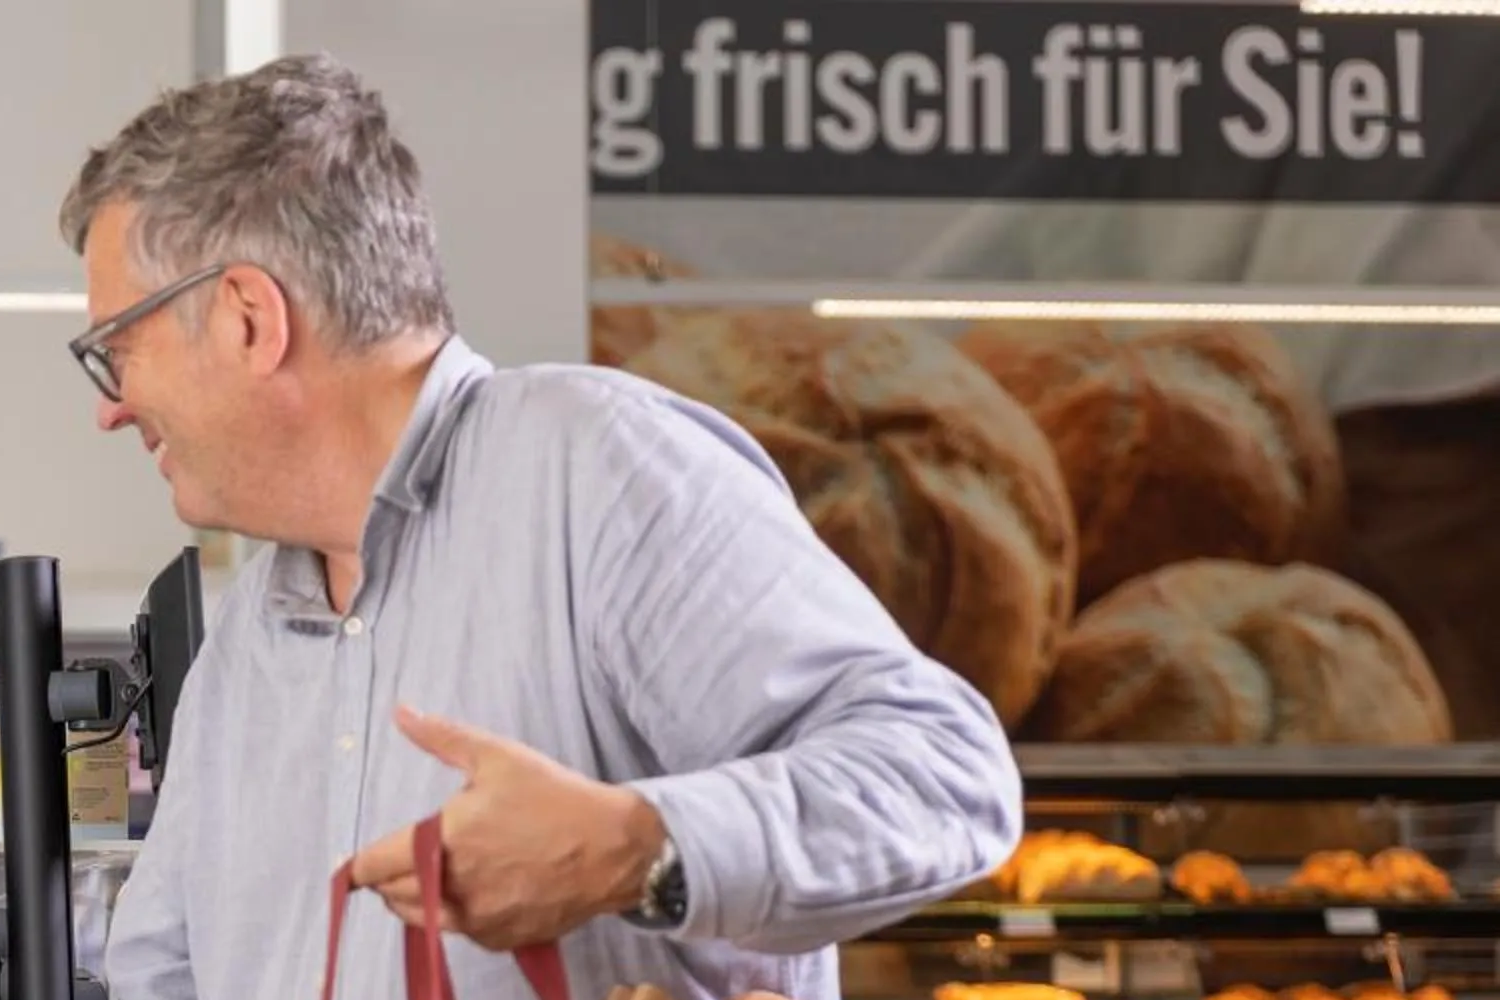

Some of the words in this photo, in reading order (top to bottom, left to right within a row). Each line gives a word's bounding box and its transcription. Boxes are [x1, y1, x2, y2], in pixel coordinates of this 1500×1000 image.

[684, 18, 1011, 154] frisch
[1033, 24, 1201, 156] für
[1220, 26, 1426, 159] Sie!
